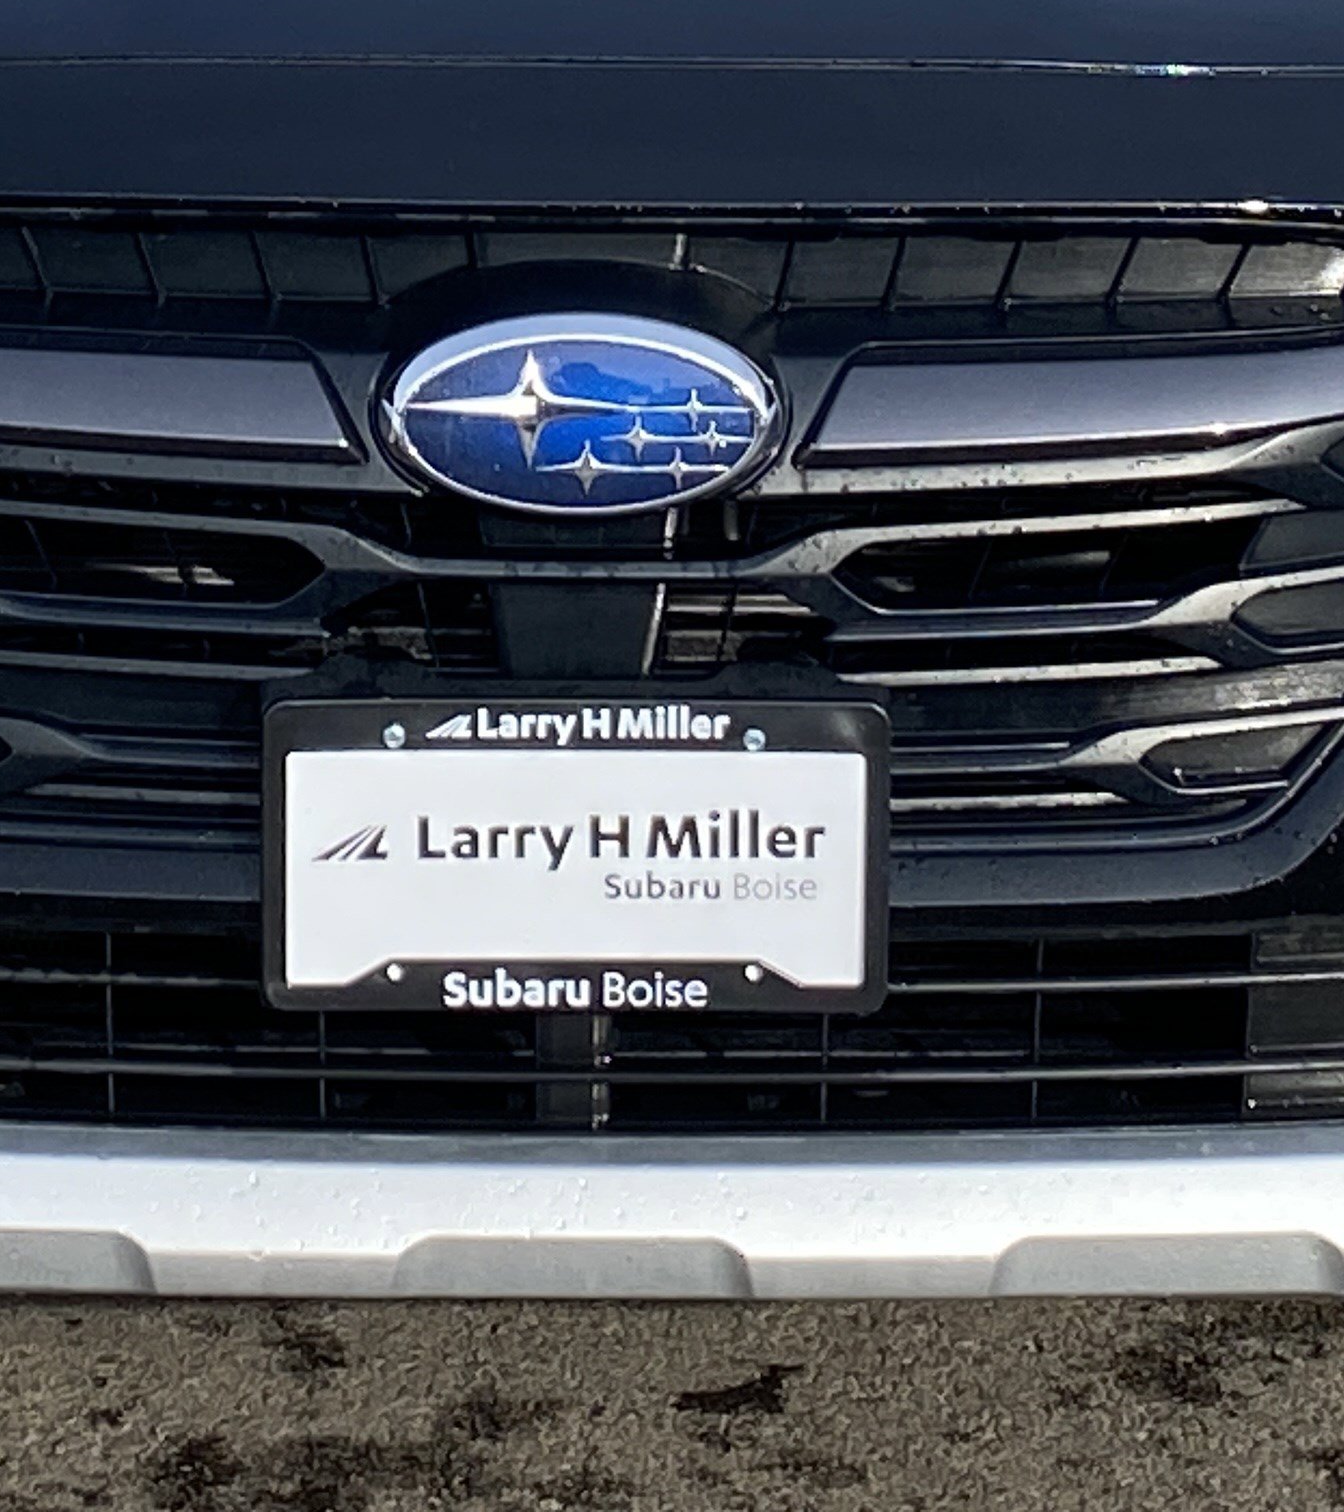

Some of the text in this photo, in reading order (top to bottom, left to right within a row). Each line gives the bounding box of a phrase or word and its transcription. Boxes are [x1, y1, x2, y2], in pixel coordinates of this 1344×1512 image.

[476, 704, 731, 746] Larry H Miller
[416, 809, 826, 871] Larry H Miller
[604, 871, 819, 900] Subaru Boise
[442, 967, 709, 1009] Subaru Boise
